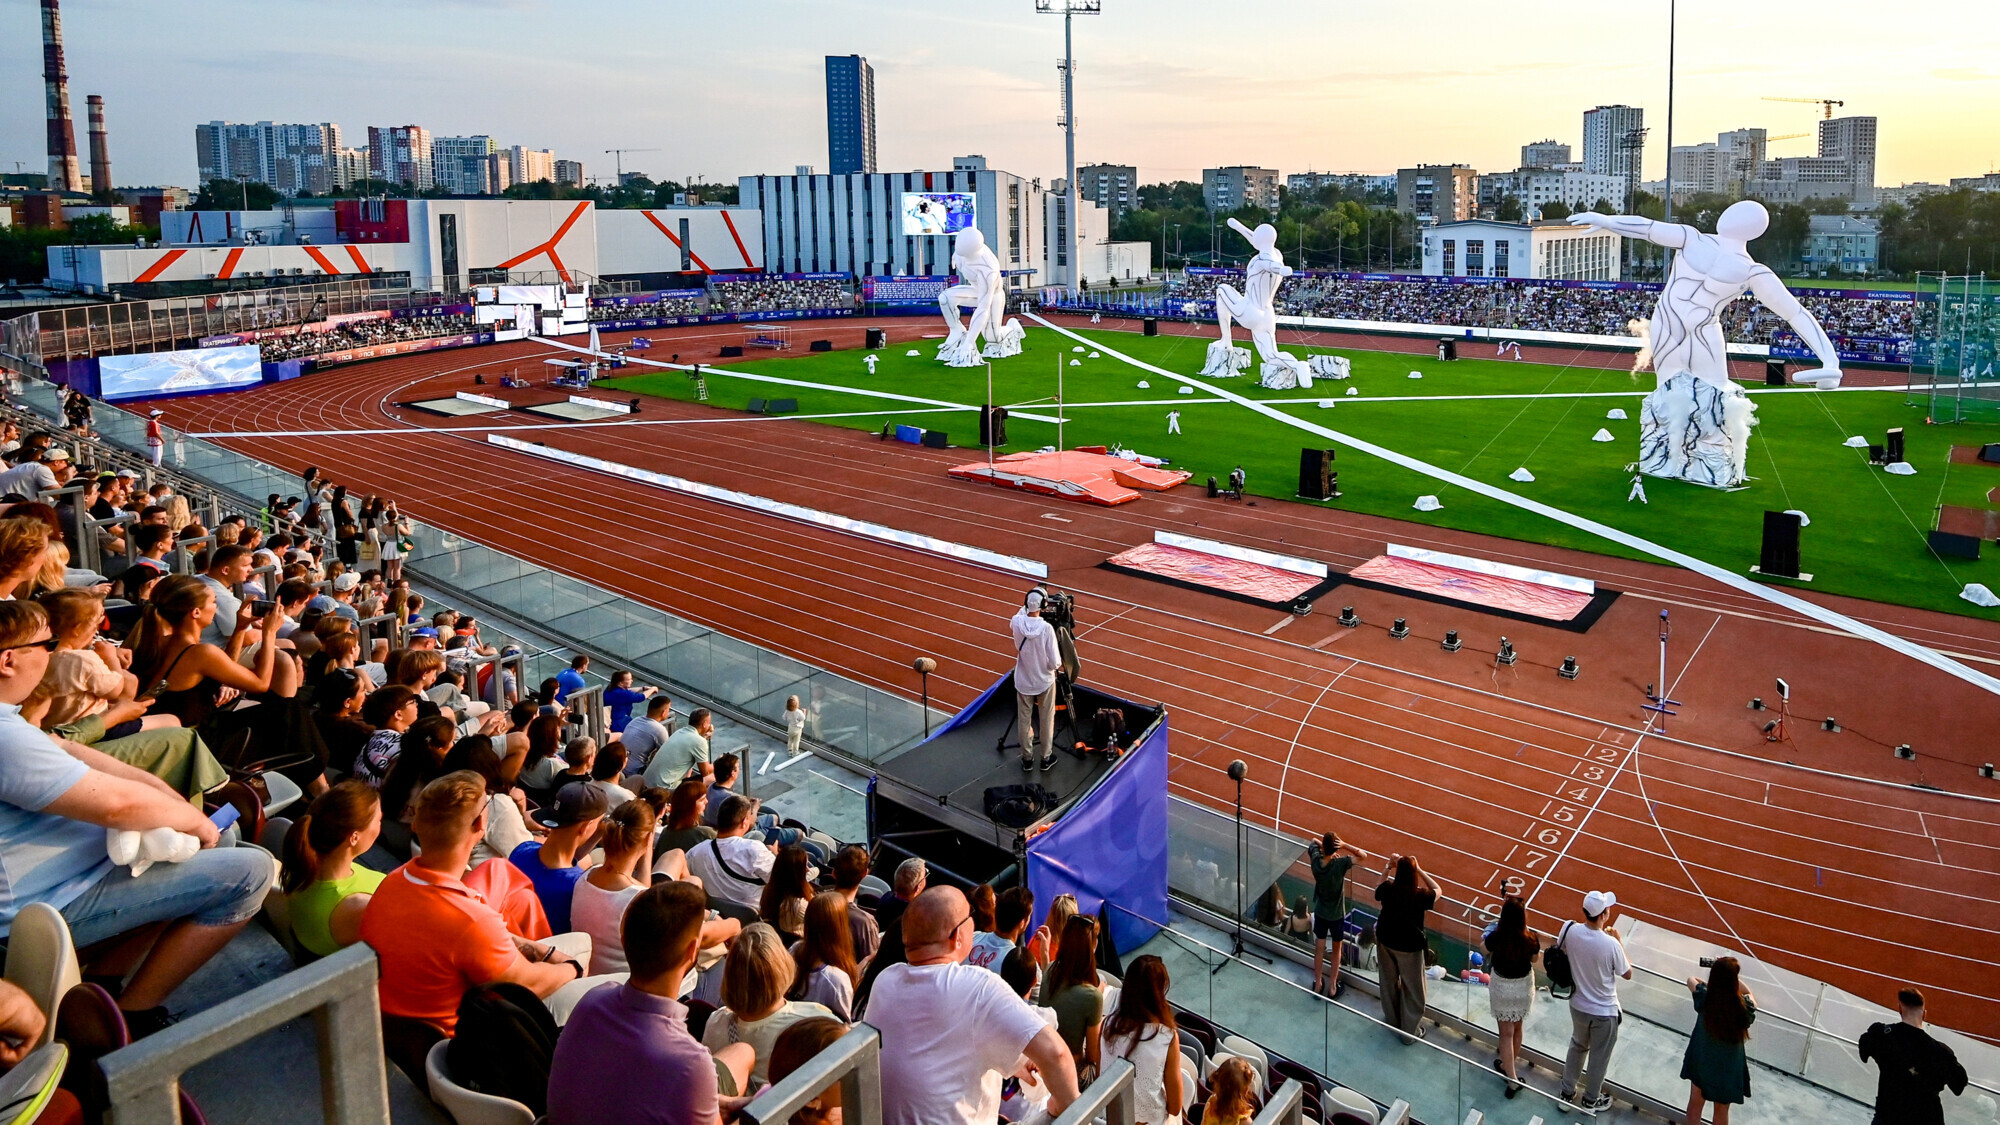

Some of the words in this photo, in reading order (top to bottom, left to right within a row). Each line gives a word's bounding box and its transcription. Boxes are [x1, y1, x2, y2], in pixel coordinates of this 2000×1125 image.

[1609, 733, 1625, 745] 1
[1596, 749, 1618, 763] 2
[1583, 766, 1605, 781] 3
[1568, 787, 1589, 802] 4
[1553, 806, 1578, 822] 5
[1538, 829, 1562, 845] 6
[1526, 850, 1549, 869] 7
[1501, 876, 1526, 896] 8
[1478, 903, 1502, 923] 9
